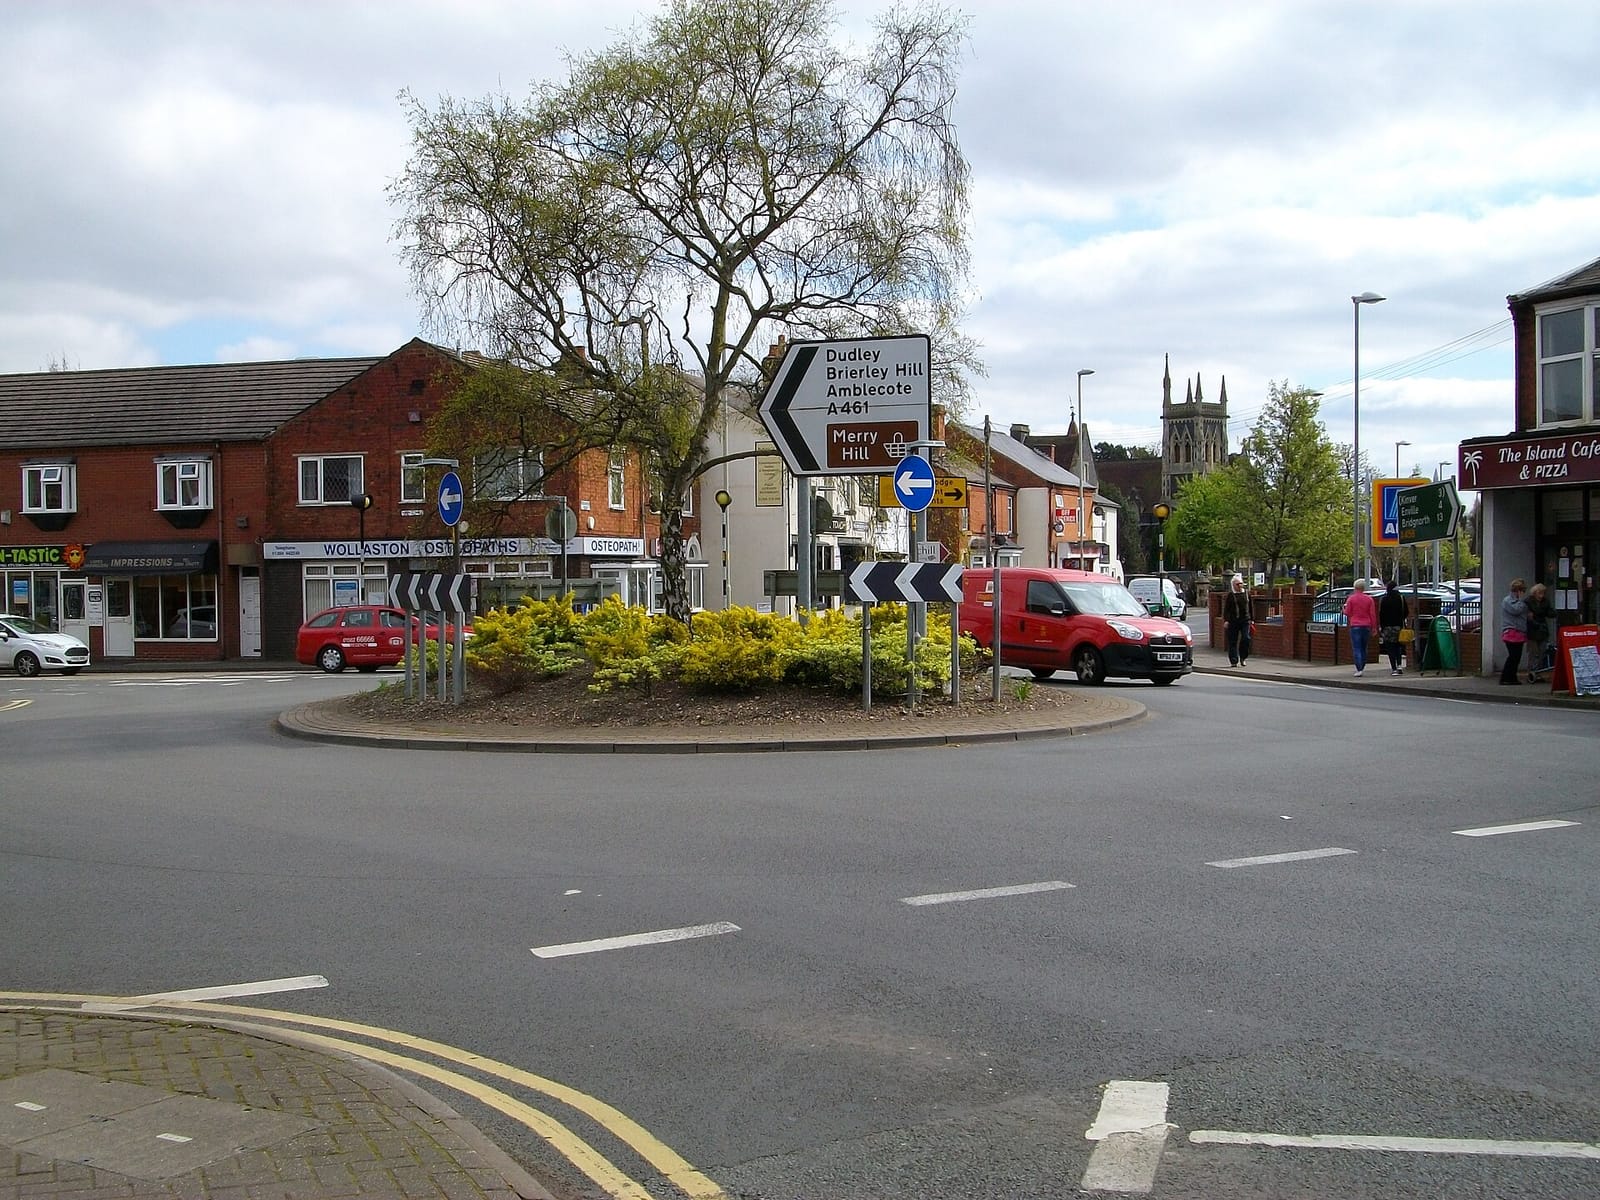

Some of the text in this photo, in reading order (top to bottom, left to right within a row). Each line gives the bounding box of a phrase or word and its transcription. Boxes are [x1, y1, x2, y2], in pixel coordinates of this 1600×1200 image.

[826, 347, 881, 364] Dudley
[827, 362, 924, 381] Brierley Hill
[827, 381, 912, 397] Amblecote
[833, 428, 878, 444] Merry
[842, 446, 870, 461] Hill
[1498, 448, 1522, 463] The
[1525, 442, 1567, 461] Island
[1519, 463, 1568, 480] & PIZZA
[935, 479, 953, 487] odge
[324, 540, 518, 556] WOLLASTON OSTOPATHS
[591, 540, 638, 552] OSTEOPATH
[110, 558, 173, 568] IMPRESSIONS
